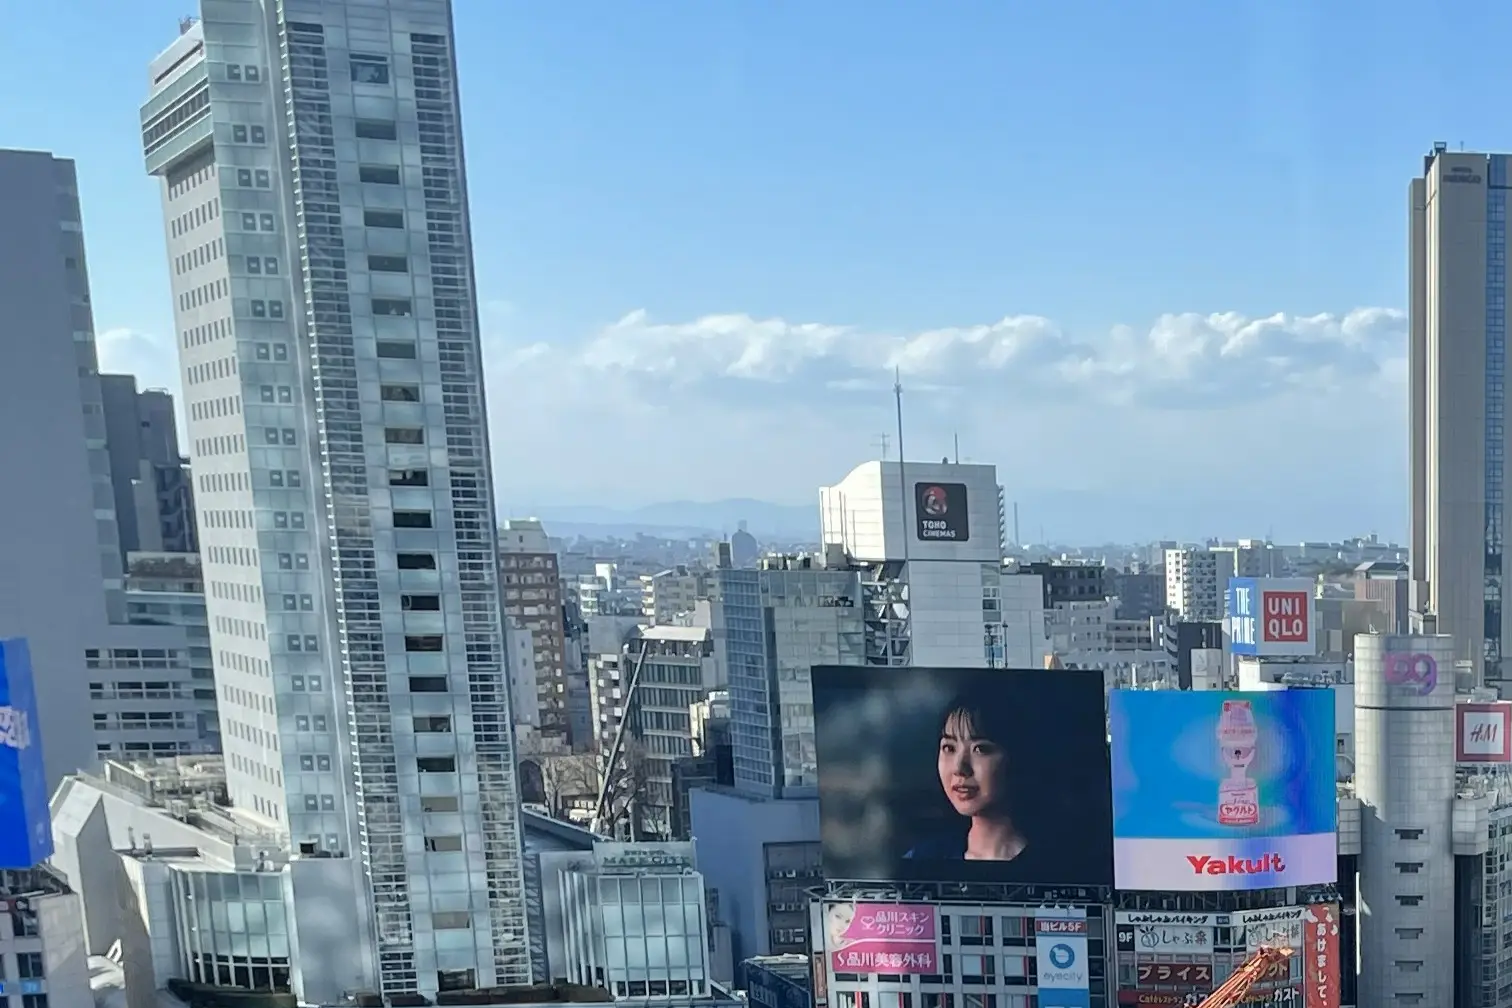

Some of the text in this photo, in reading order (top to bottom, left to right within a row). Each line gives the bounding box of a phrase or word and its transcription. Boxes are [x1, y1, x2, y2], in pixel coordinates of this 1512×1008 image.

[922, 520, 947, 529] TOHO
[922, 529, 956, 538] CINEMAS
[1267, 597, 1300, 616] UNI
[1268, 618, 1303, 639] QLO
[1186, 853, 1286, 875] Yakult
[875, 910, 930, 923] 品川スキン
[876, 924, 924, 936] クリニック
[1118, 932, 1133, 943] 9F
[1043, 970, 1083, 983] eyecity
[1274, 988, 1300, 1002] ガスト
